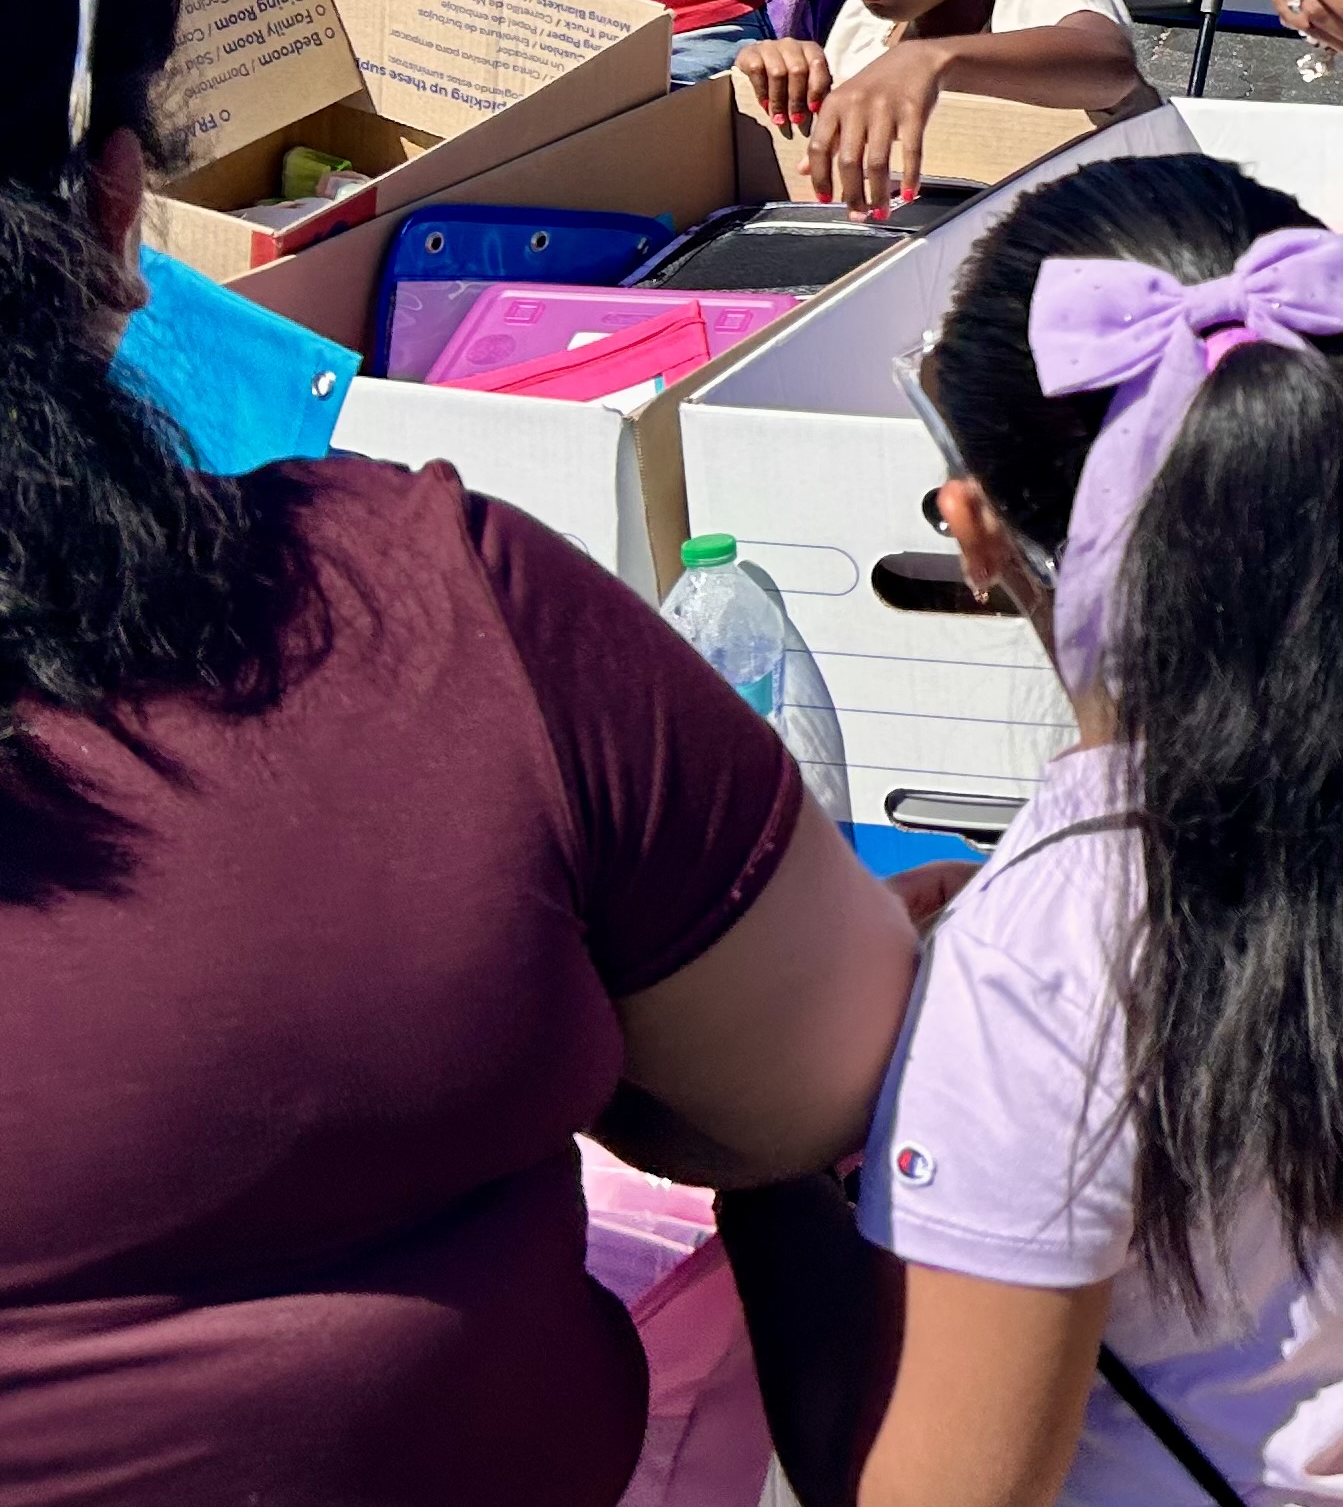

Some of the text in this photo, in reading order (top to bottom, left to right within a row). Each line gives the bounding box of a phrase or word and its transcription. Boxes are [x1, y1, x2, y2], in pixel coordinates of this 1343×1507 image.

[214, 5, 258, 31] Room
[266, 9, 314, 38] Family
[564, 20, 596, 38] Truck
[588, 10, 632, 33] Moving
[222, 29, 266, 55] Room
[257, 31, 324, 67] Bedroom
[546, 30, 581, 49] Paper
[183, 62, 251, 100] Dormitorio
[389, 70, 427, 92] these
[430, 83, 448, 97] up
